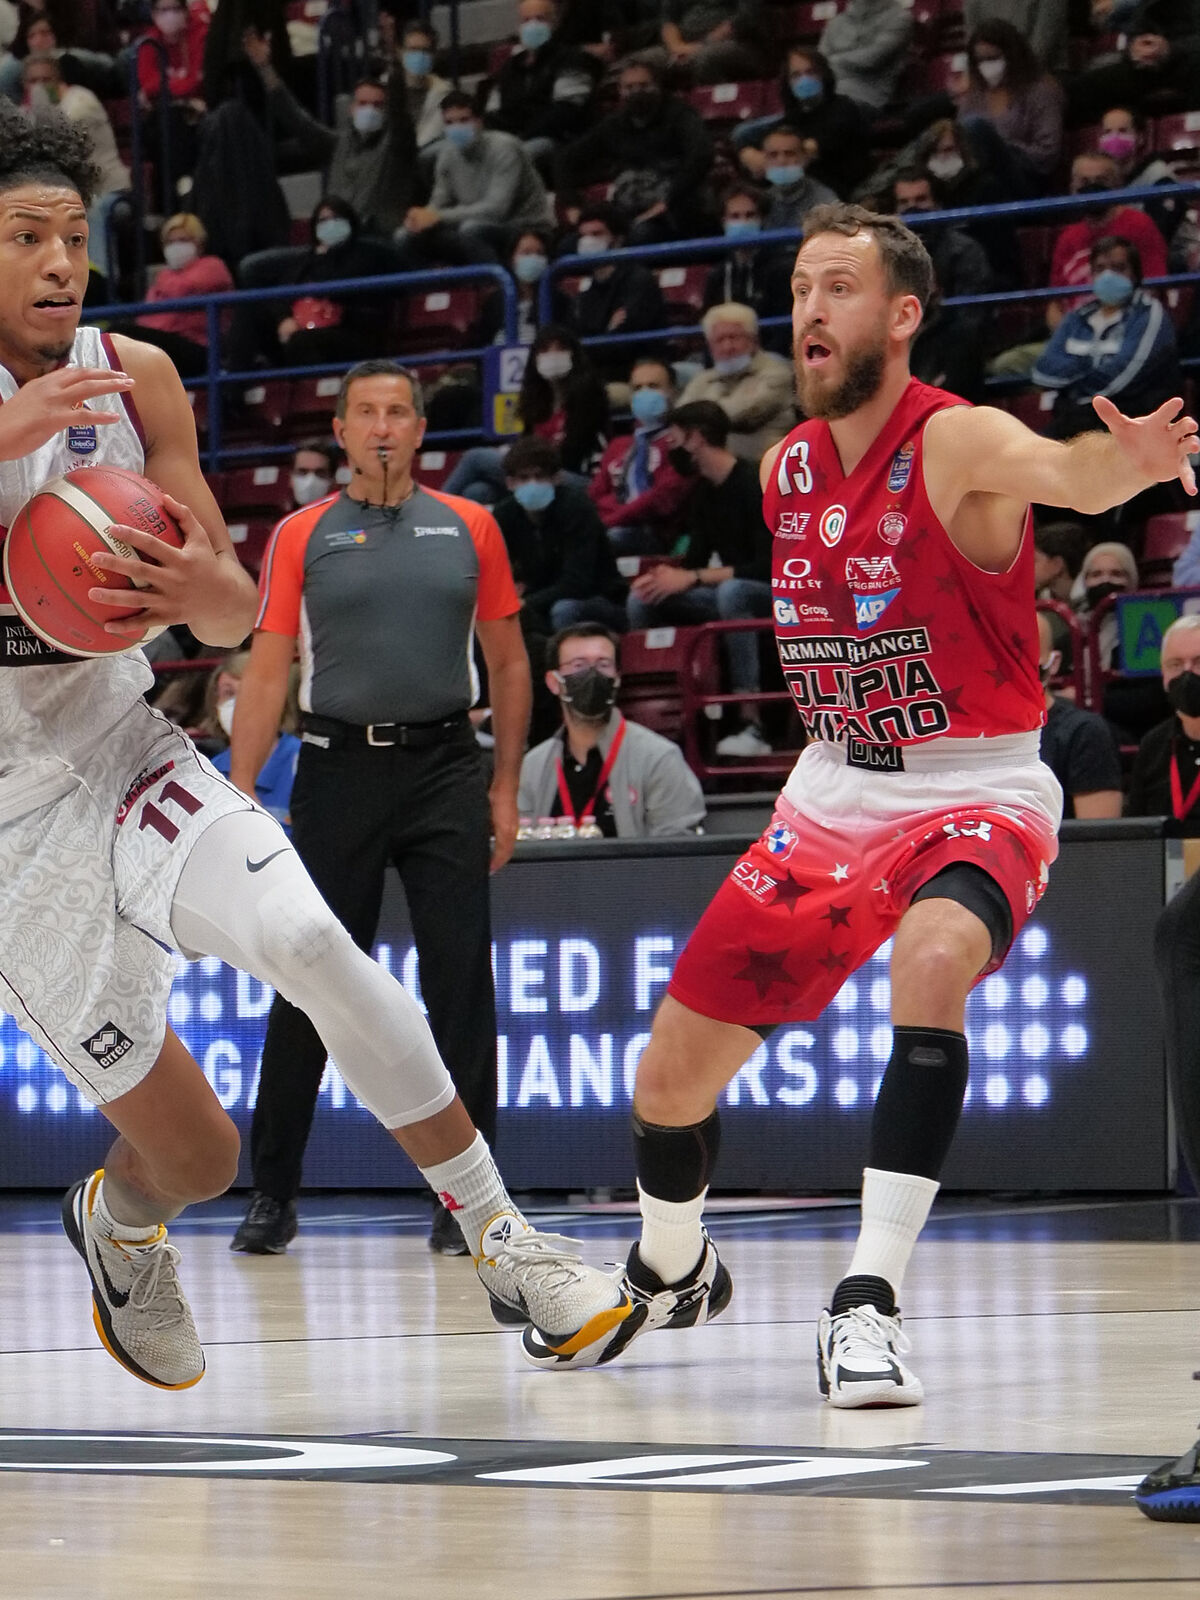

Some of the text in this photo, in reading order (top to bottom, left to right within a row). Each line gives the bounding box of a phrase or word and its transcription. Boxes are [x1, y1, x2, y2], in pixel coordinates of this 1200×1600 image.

[777, 440, 813, 496] 13
[134, 497, 167, 535] FIBA
[778, 512, 812, 533] EA7
[771, 578, 823, 589] OAKLEY
[800, 604, 830, 618] Group
[855, 600, 887, 624] AP
[6, 639, 42, 656] RBM
[781, 641, 843, 661] ARMANI
[784, 659, 942, 713] OLIPIA
[138, 780, 205, 845] 11
[733, 861, 778, 895] EA7
